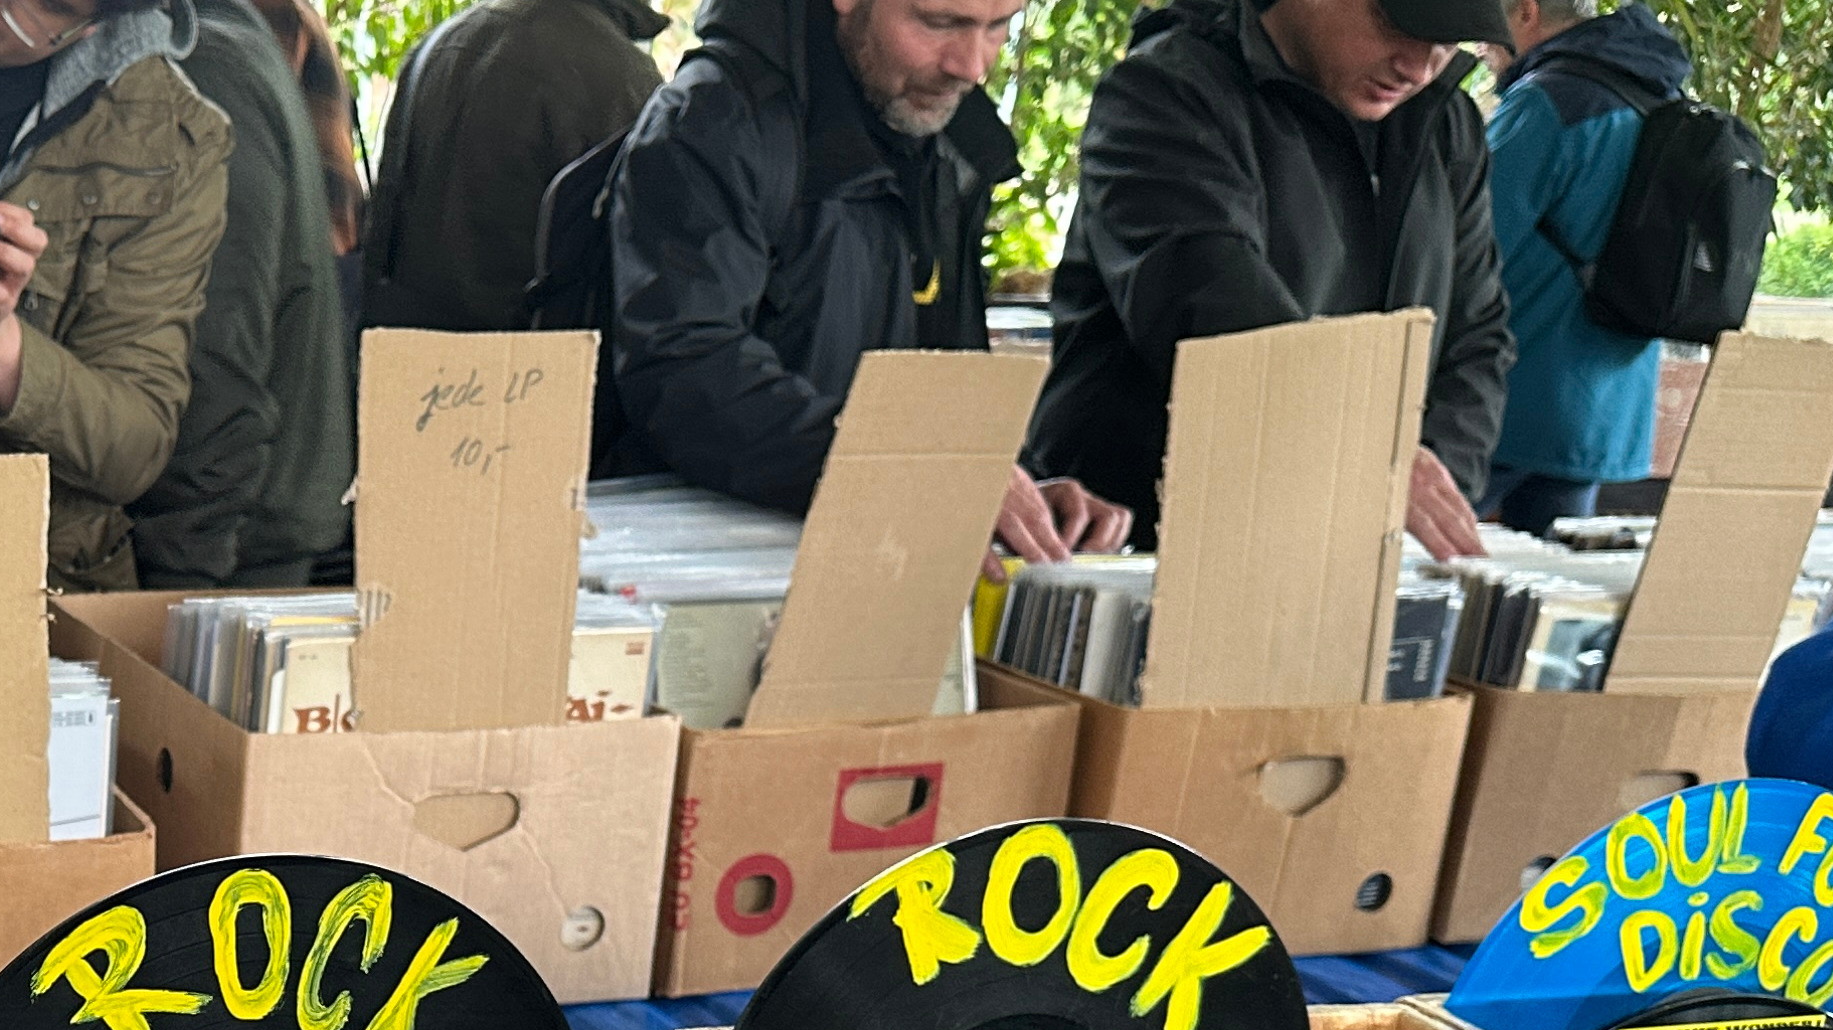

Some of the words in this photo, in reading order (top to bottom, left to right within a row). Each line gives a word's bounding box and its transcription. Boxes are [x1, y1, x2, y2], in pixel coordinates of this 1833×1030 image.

[415, 366, 487, 433] jede
[503, 367, 545, 404] LP
[1519, 781, 1762, 960] SOUL
